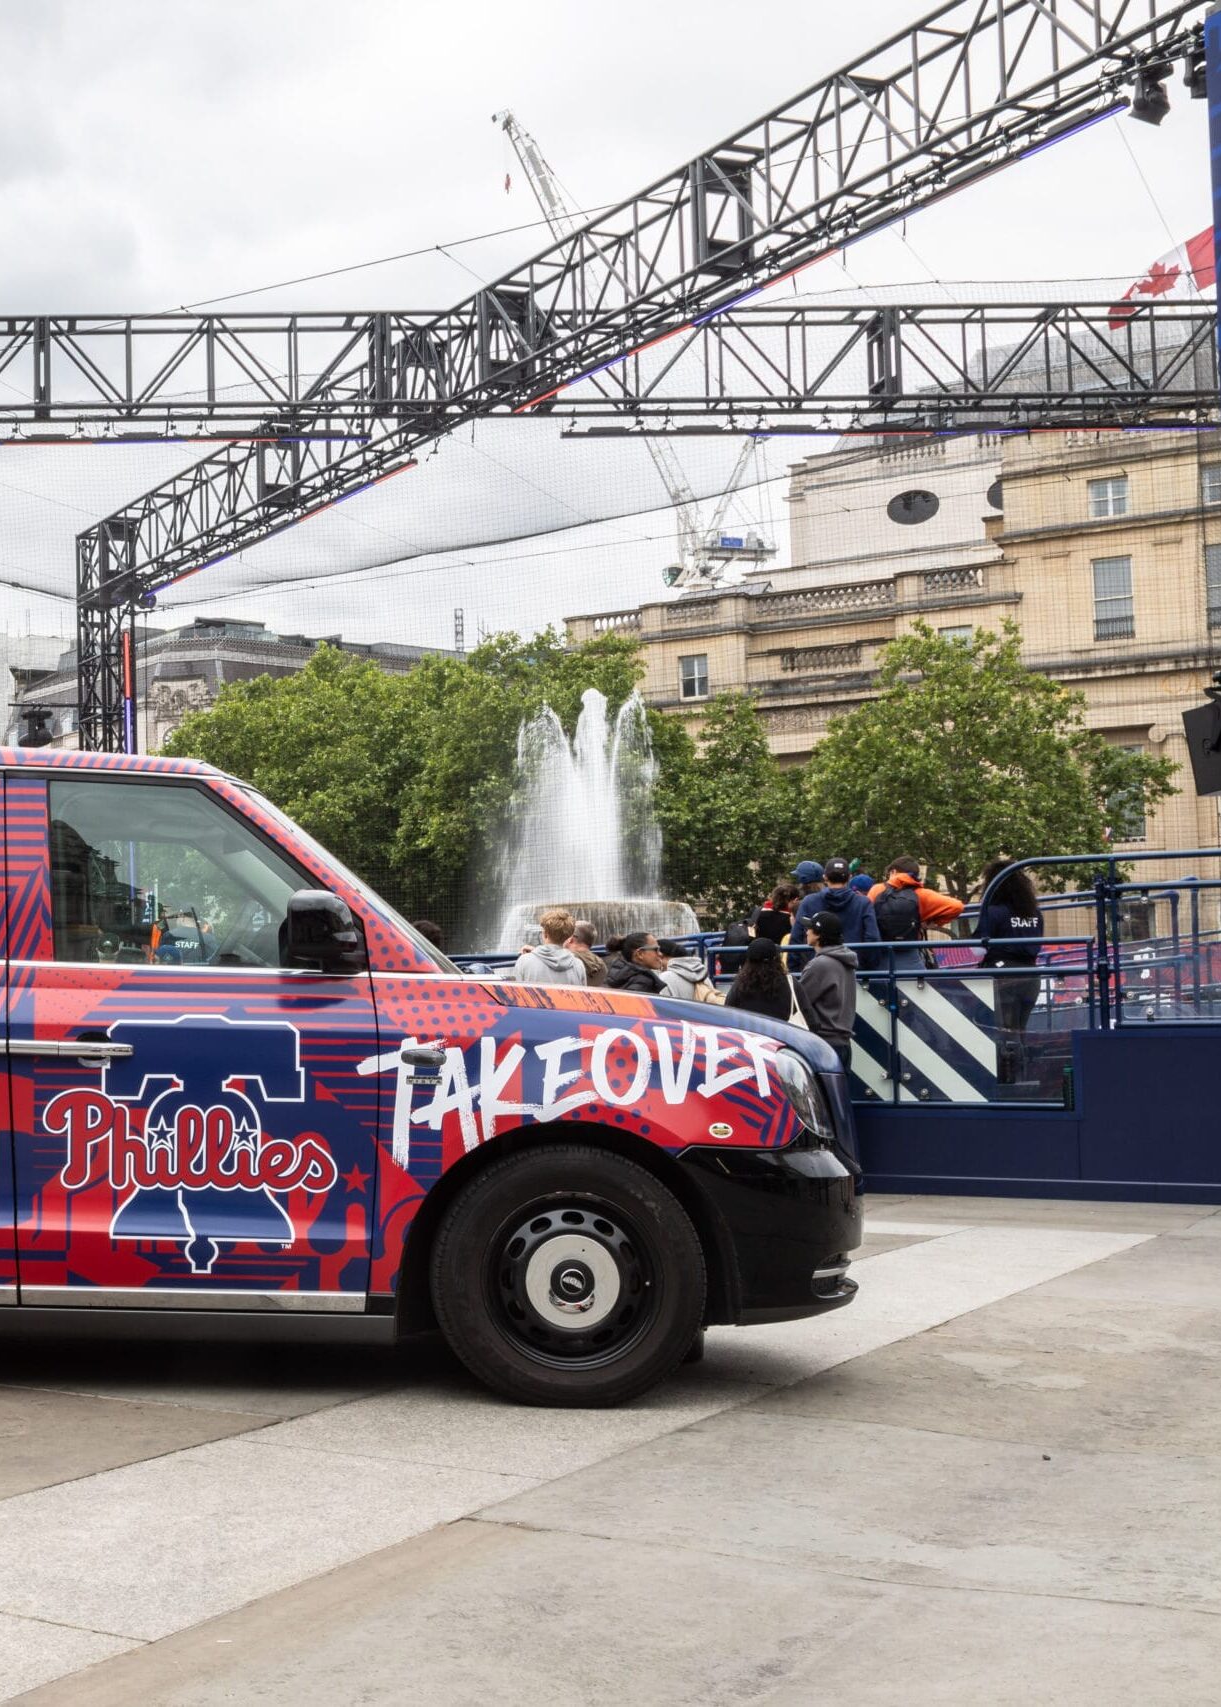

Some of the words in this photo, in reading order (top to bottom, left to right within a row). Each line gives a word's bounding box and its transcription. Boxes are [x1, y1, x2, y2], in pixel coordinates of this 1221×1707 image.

[1010, 917, 1039, 928] STAFF
[175, 941, 199, 949] STAFF
[41, 1088, 339, 1193] Phillies
